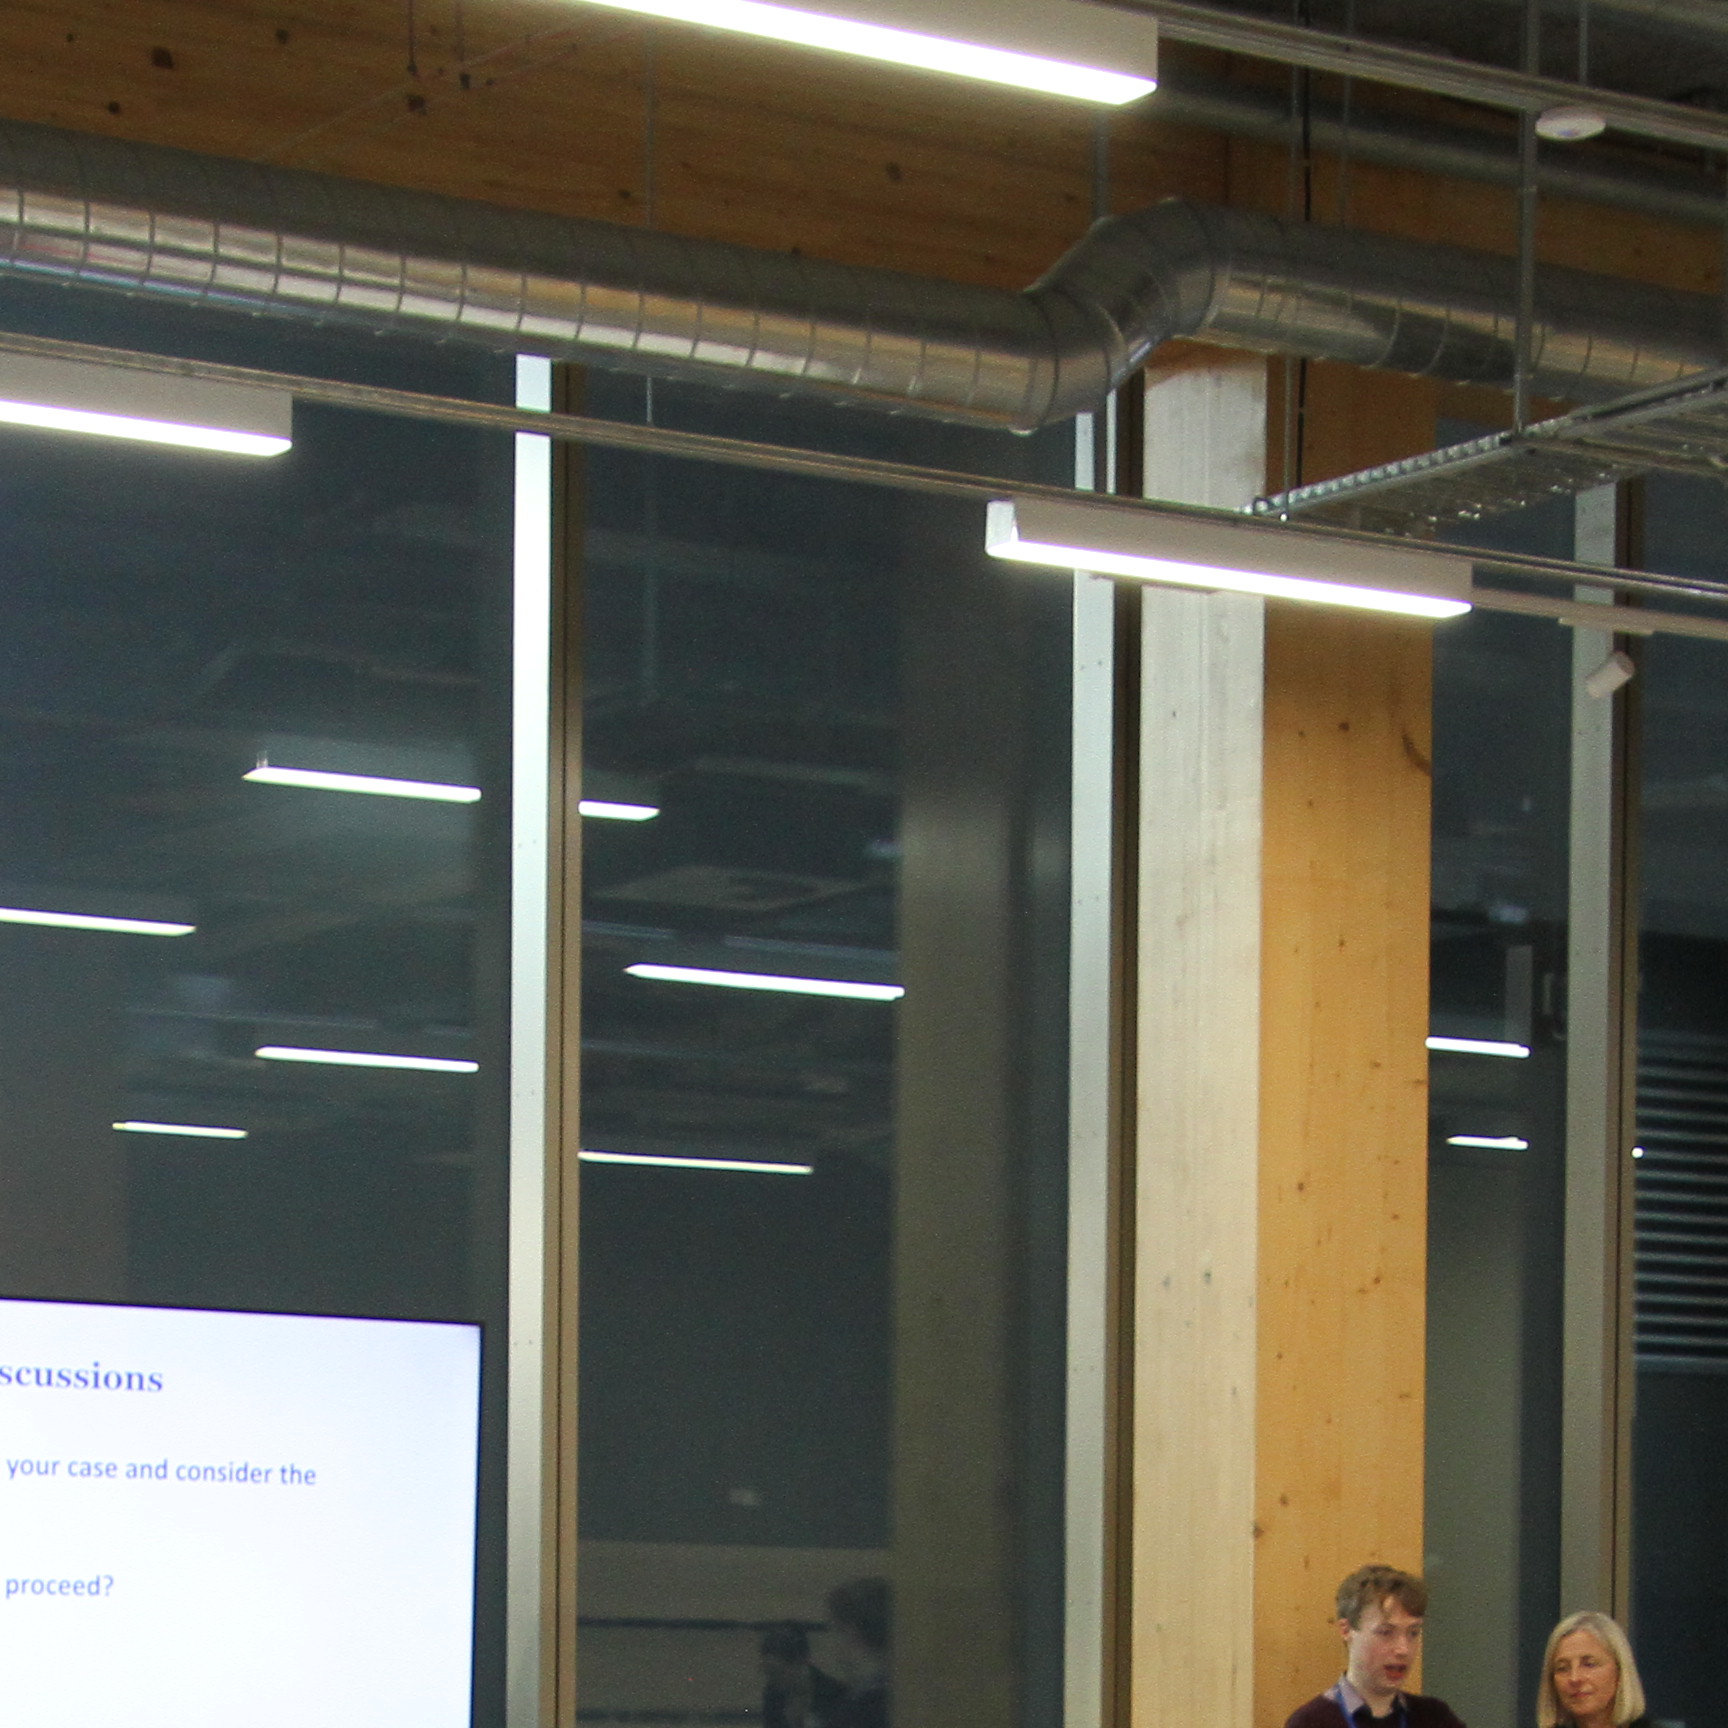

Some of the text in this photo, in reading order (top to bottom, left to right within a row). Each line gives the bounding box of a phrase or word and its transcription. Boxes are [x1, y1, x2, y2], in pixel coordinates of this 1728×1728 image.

[6, 1458, 61, 1481] your
[67, 1460, 118, 1479] case
[124, 1458, 169, 1481] and
[175, 1461, 273, 1484] consider
[278, 1462, 317, 1486] the
[5, 1574, 115, 1600] proceed?
